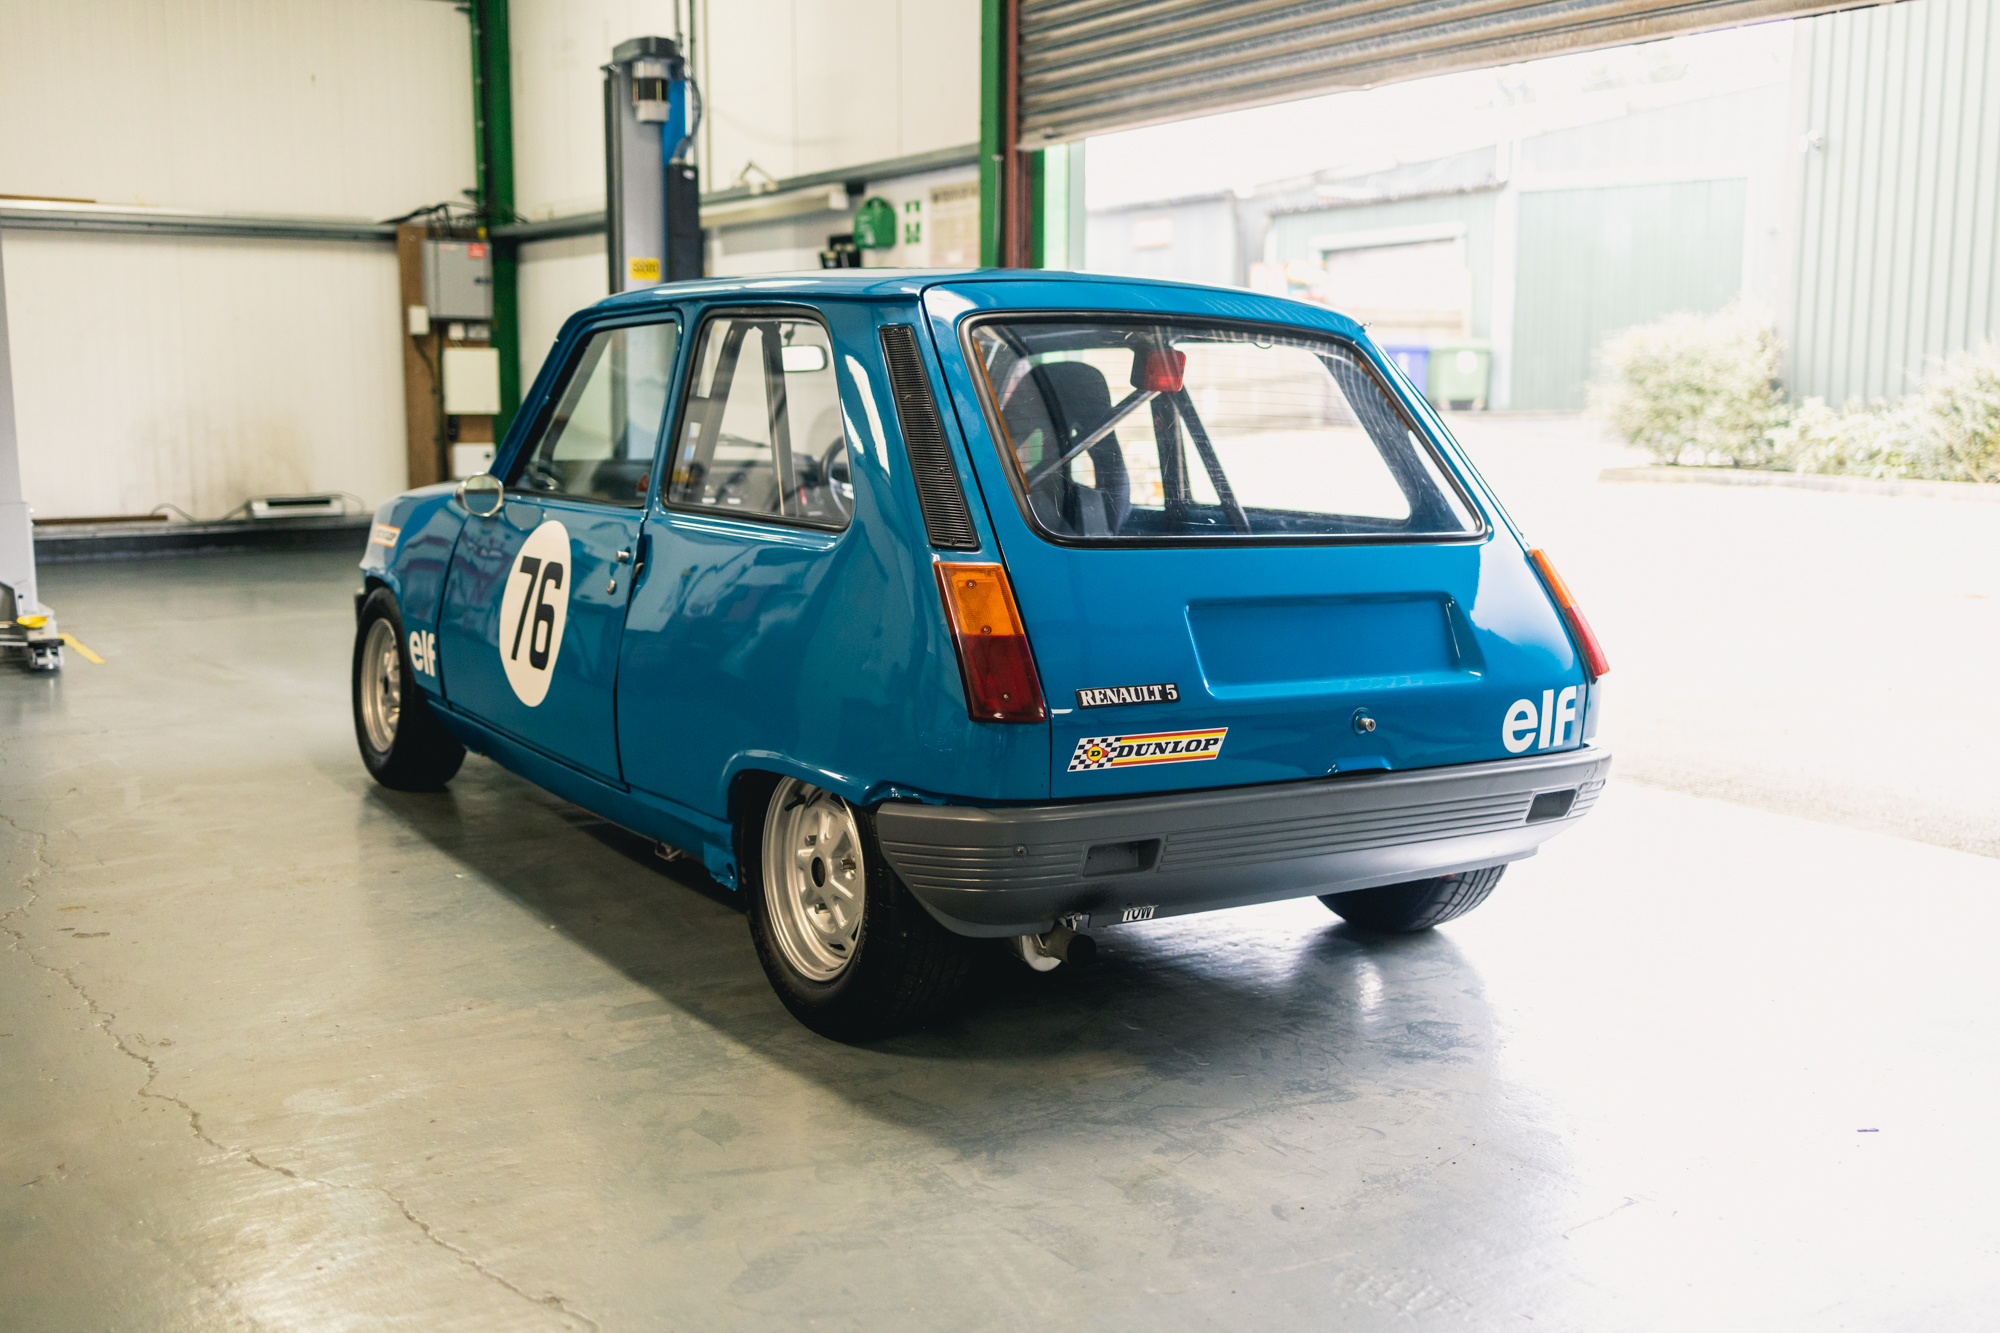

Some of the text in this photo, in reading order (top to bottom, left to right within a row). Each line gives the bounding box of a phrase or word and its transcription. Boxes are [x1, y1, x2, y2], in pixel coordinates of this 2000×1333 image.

[511, 556, 564, 671] 76
[409, 630, 436, 677] elf
[1079, 684, 1178, 706] RENAULT 5
[1502, 686, 1577, 753] elf
[1115, 737, 1220, 758] DUNLOP
